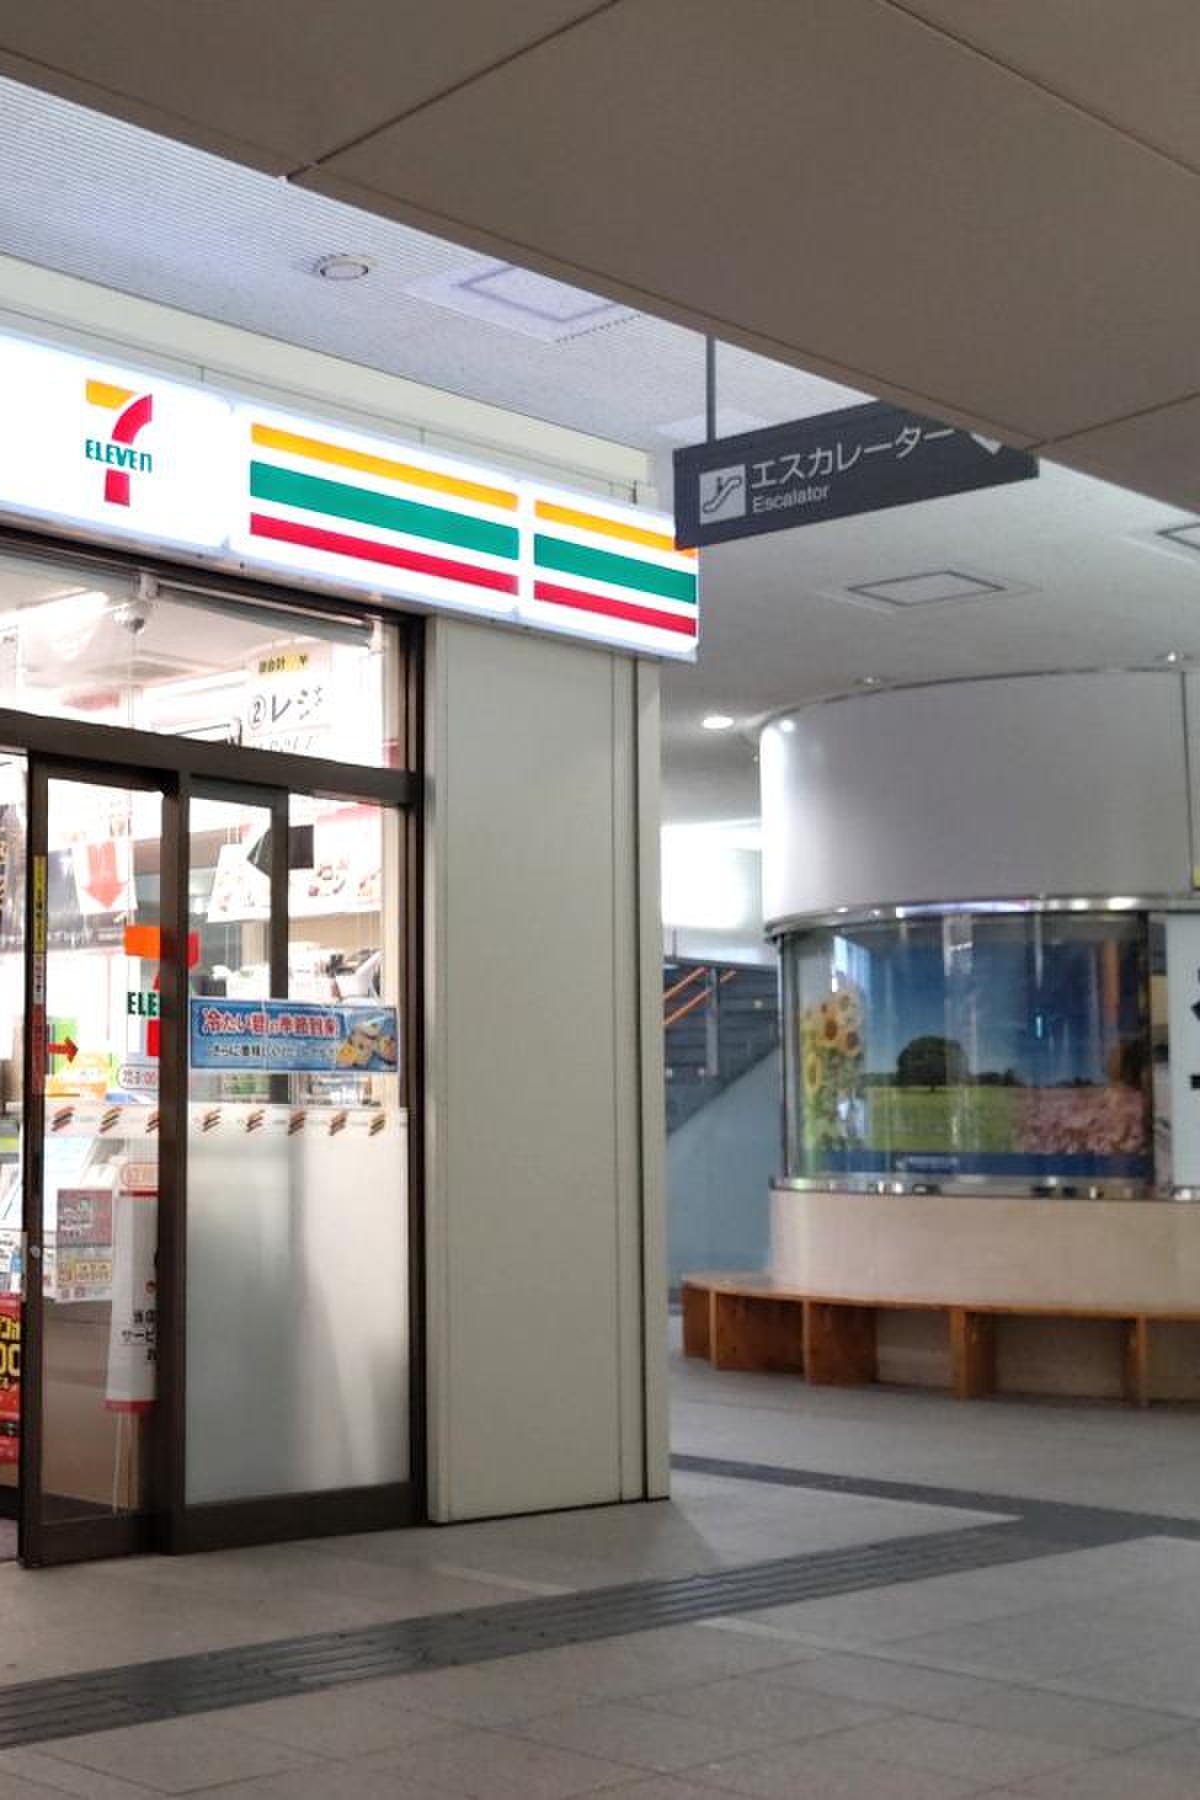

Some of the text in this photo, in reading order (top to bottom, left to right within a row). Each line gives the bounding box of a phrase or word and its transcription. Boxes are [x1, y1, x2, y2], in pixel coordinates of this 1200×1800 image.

[751, 426, 955, 489] エスカレーター
[752, 484, 830, 513] Escalator
[127, 991, 159, 1017] ELE
